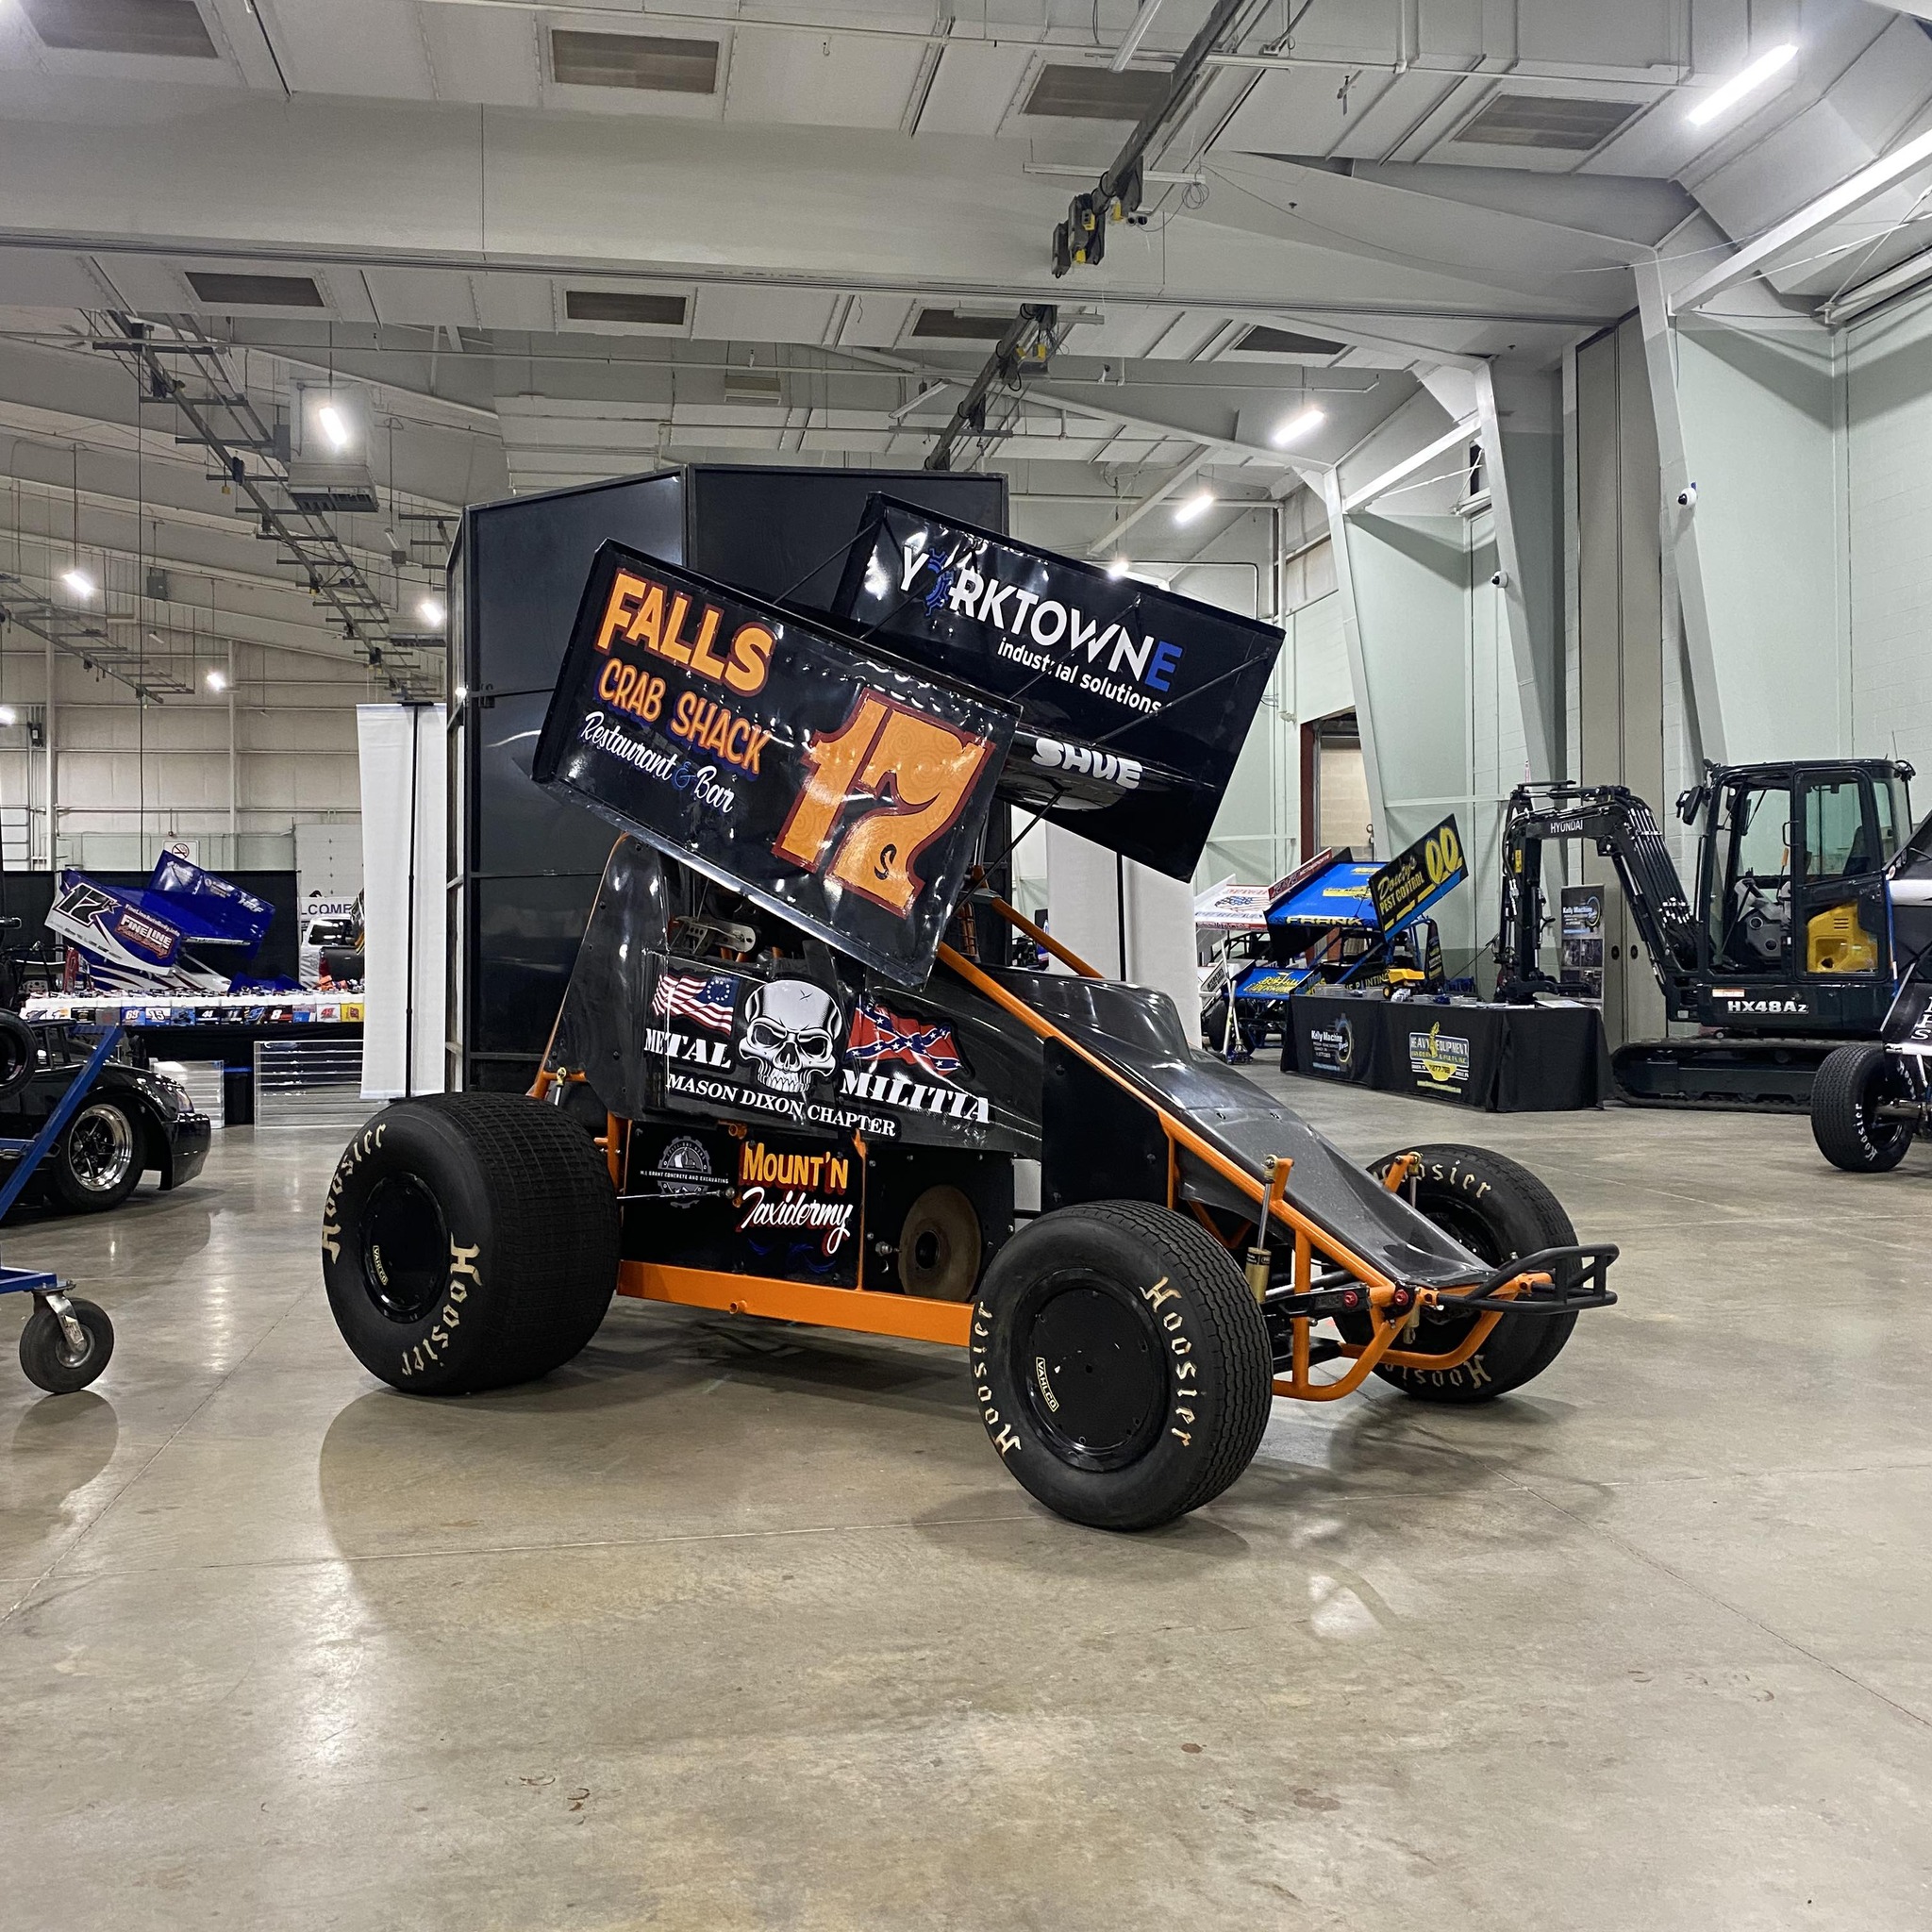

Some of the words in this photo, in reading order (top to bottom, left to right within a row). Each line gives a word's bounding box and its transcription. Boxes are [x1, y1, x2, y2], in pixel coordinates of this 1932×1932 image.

[593, 568, 777, 696] FALLS
[595, 658, 666, 724] CRAB
[667, 691, 774, 780] SHACK
[1079, 671, 1162, 714] solutions
[579, 711, 676, 781] Restaurant
[673, 761, 697, 790] &
[694, 767, 734, 813] Bar
[1032, 737, 1143, 790] SHUE
[1550, 820, 1583, 834] HYUNDAI
[1286, 915, 1364, 925] FRANK
[1379, 893, 1396, 915] PEST
[1396, 872, 1425, 902] CONTROL
[150, 1010, 165, 1021] 15
[271, 1009, 282, 1020] 8
[643, 1027, 732, 1069] METAL
[667, 1074, 739, 1106] MASON
[740, 1090, 805, 1119] DIXON
[807, 1106, 896, 1138] CHAPTER
[839, 1069, 990, 1124] MILITIA
[321, 1124, 387, 1264] Hoosier
[740, 1187, 853, 1254] Taxidermy
[401, 1232, 483, 1375] Hoosier
[974, 1301, 1022, 1456] Hoosier
[1038, 1360, 1058, 1410] VAHLCO
[1140, 1276, 1207, 1446] Hoosier
